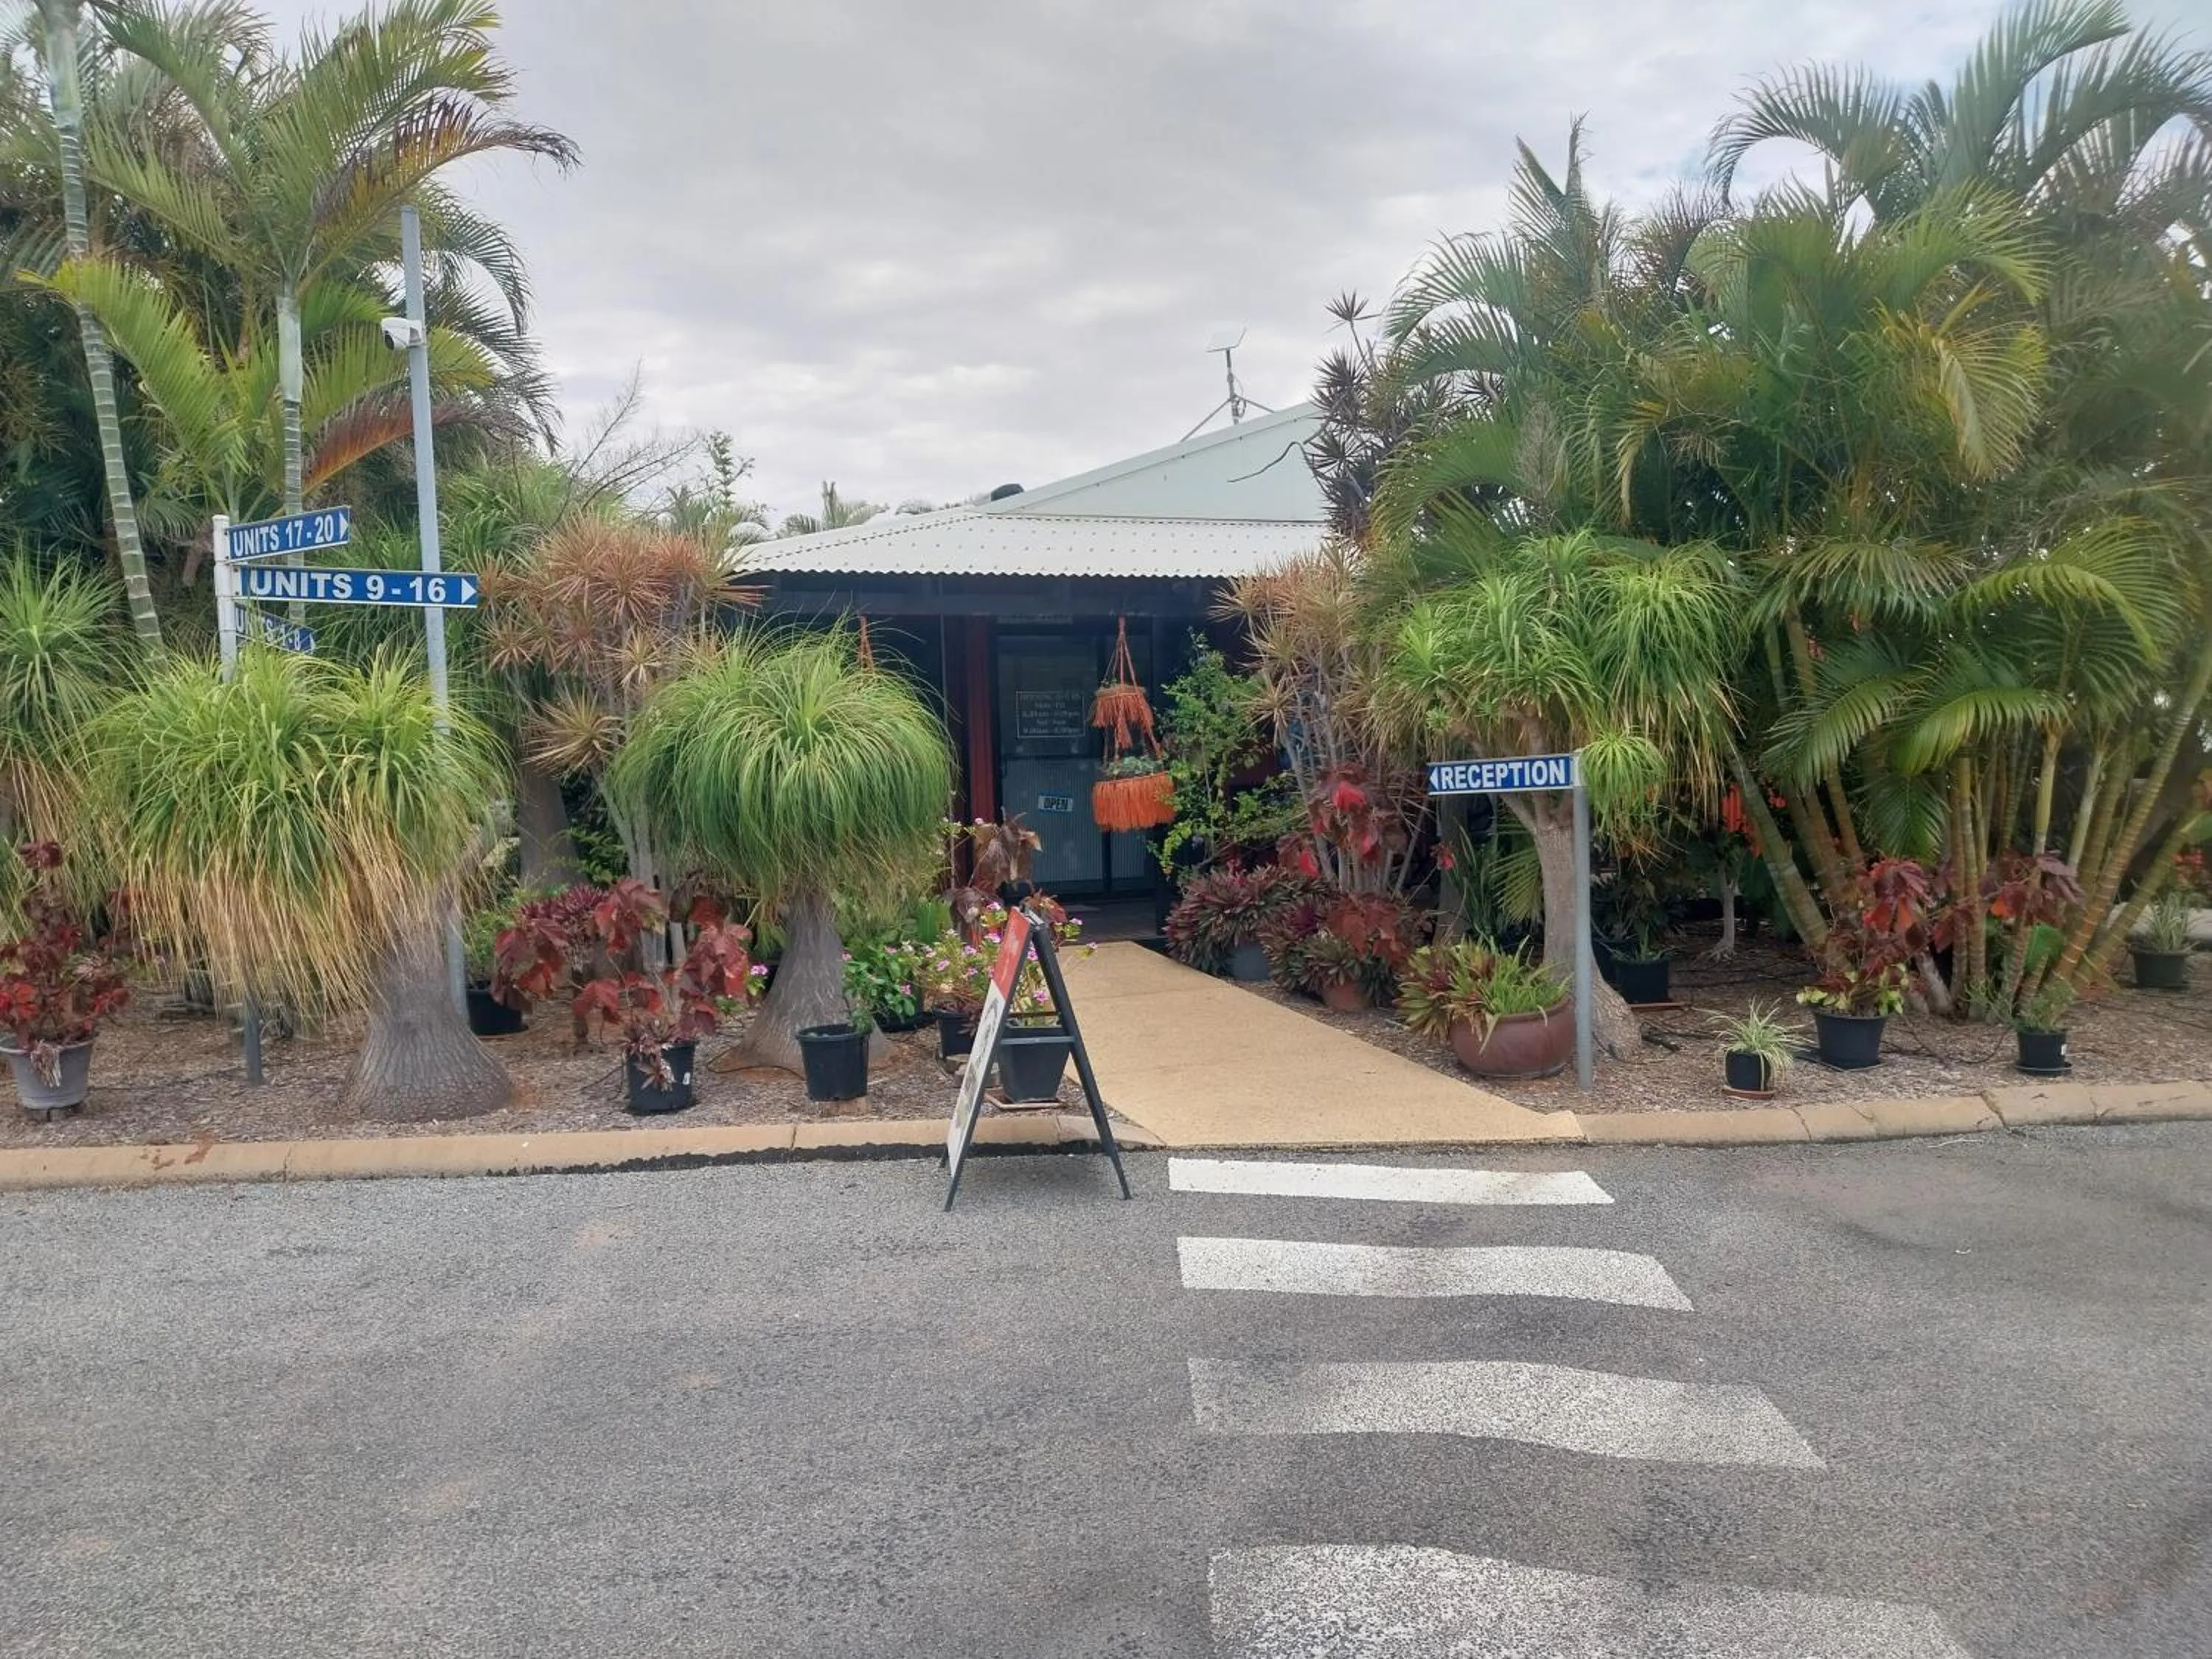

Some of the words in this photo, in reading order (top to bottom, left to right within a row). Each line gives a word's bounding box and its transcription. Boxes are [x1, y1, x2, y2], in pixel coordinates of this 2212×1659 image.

[234, 526, 279, 557] UNITS
[249, 570, 352, 599] UNITS
[1441, 759, 1565, 790] RECEPTION
[1043, 796, 1068, 810] OPEN
